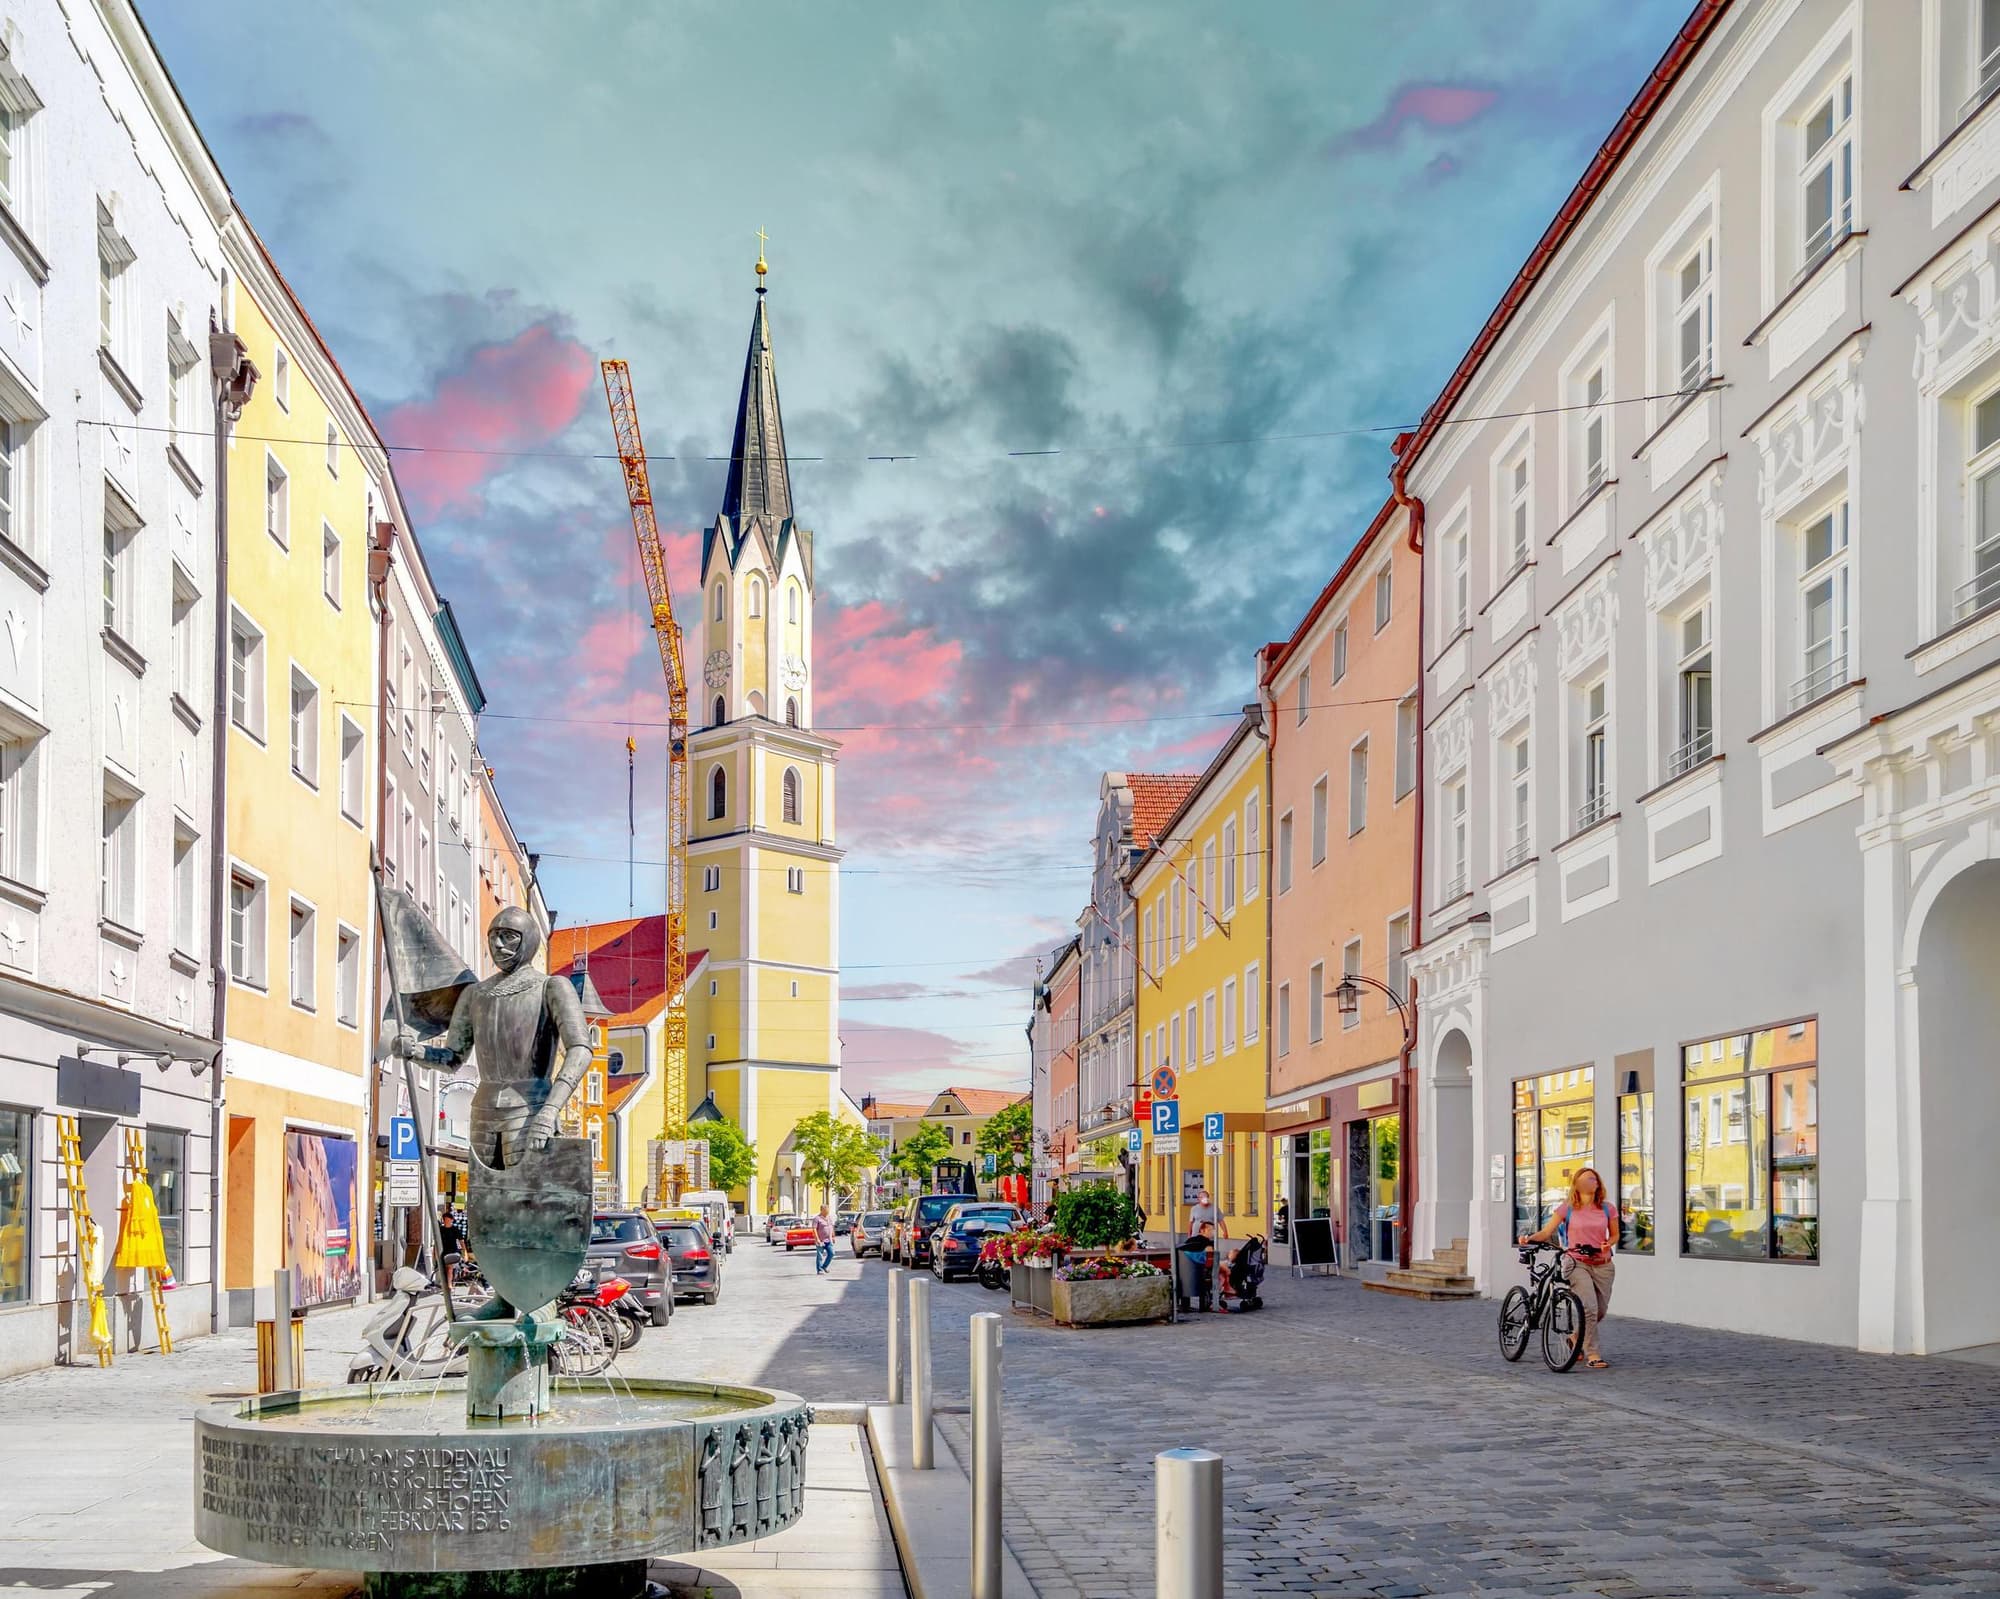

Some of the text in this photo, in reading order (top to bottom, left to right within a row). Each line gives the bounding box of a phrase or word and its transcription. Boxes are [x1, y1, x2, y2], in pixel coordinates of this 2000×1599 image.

[1156, 1105, 1171, 1131] P
[1208, 1117, 1218, 1137] P
[397, 1122, 414, 1155] P
[1131, 1132, 1138, 1149] P
[394, 1490, 511, 1510] VILSHOFEN
[380, 1511, 465, 1531] FEBRUAR
